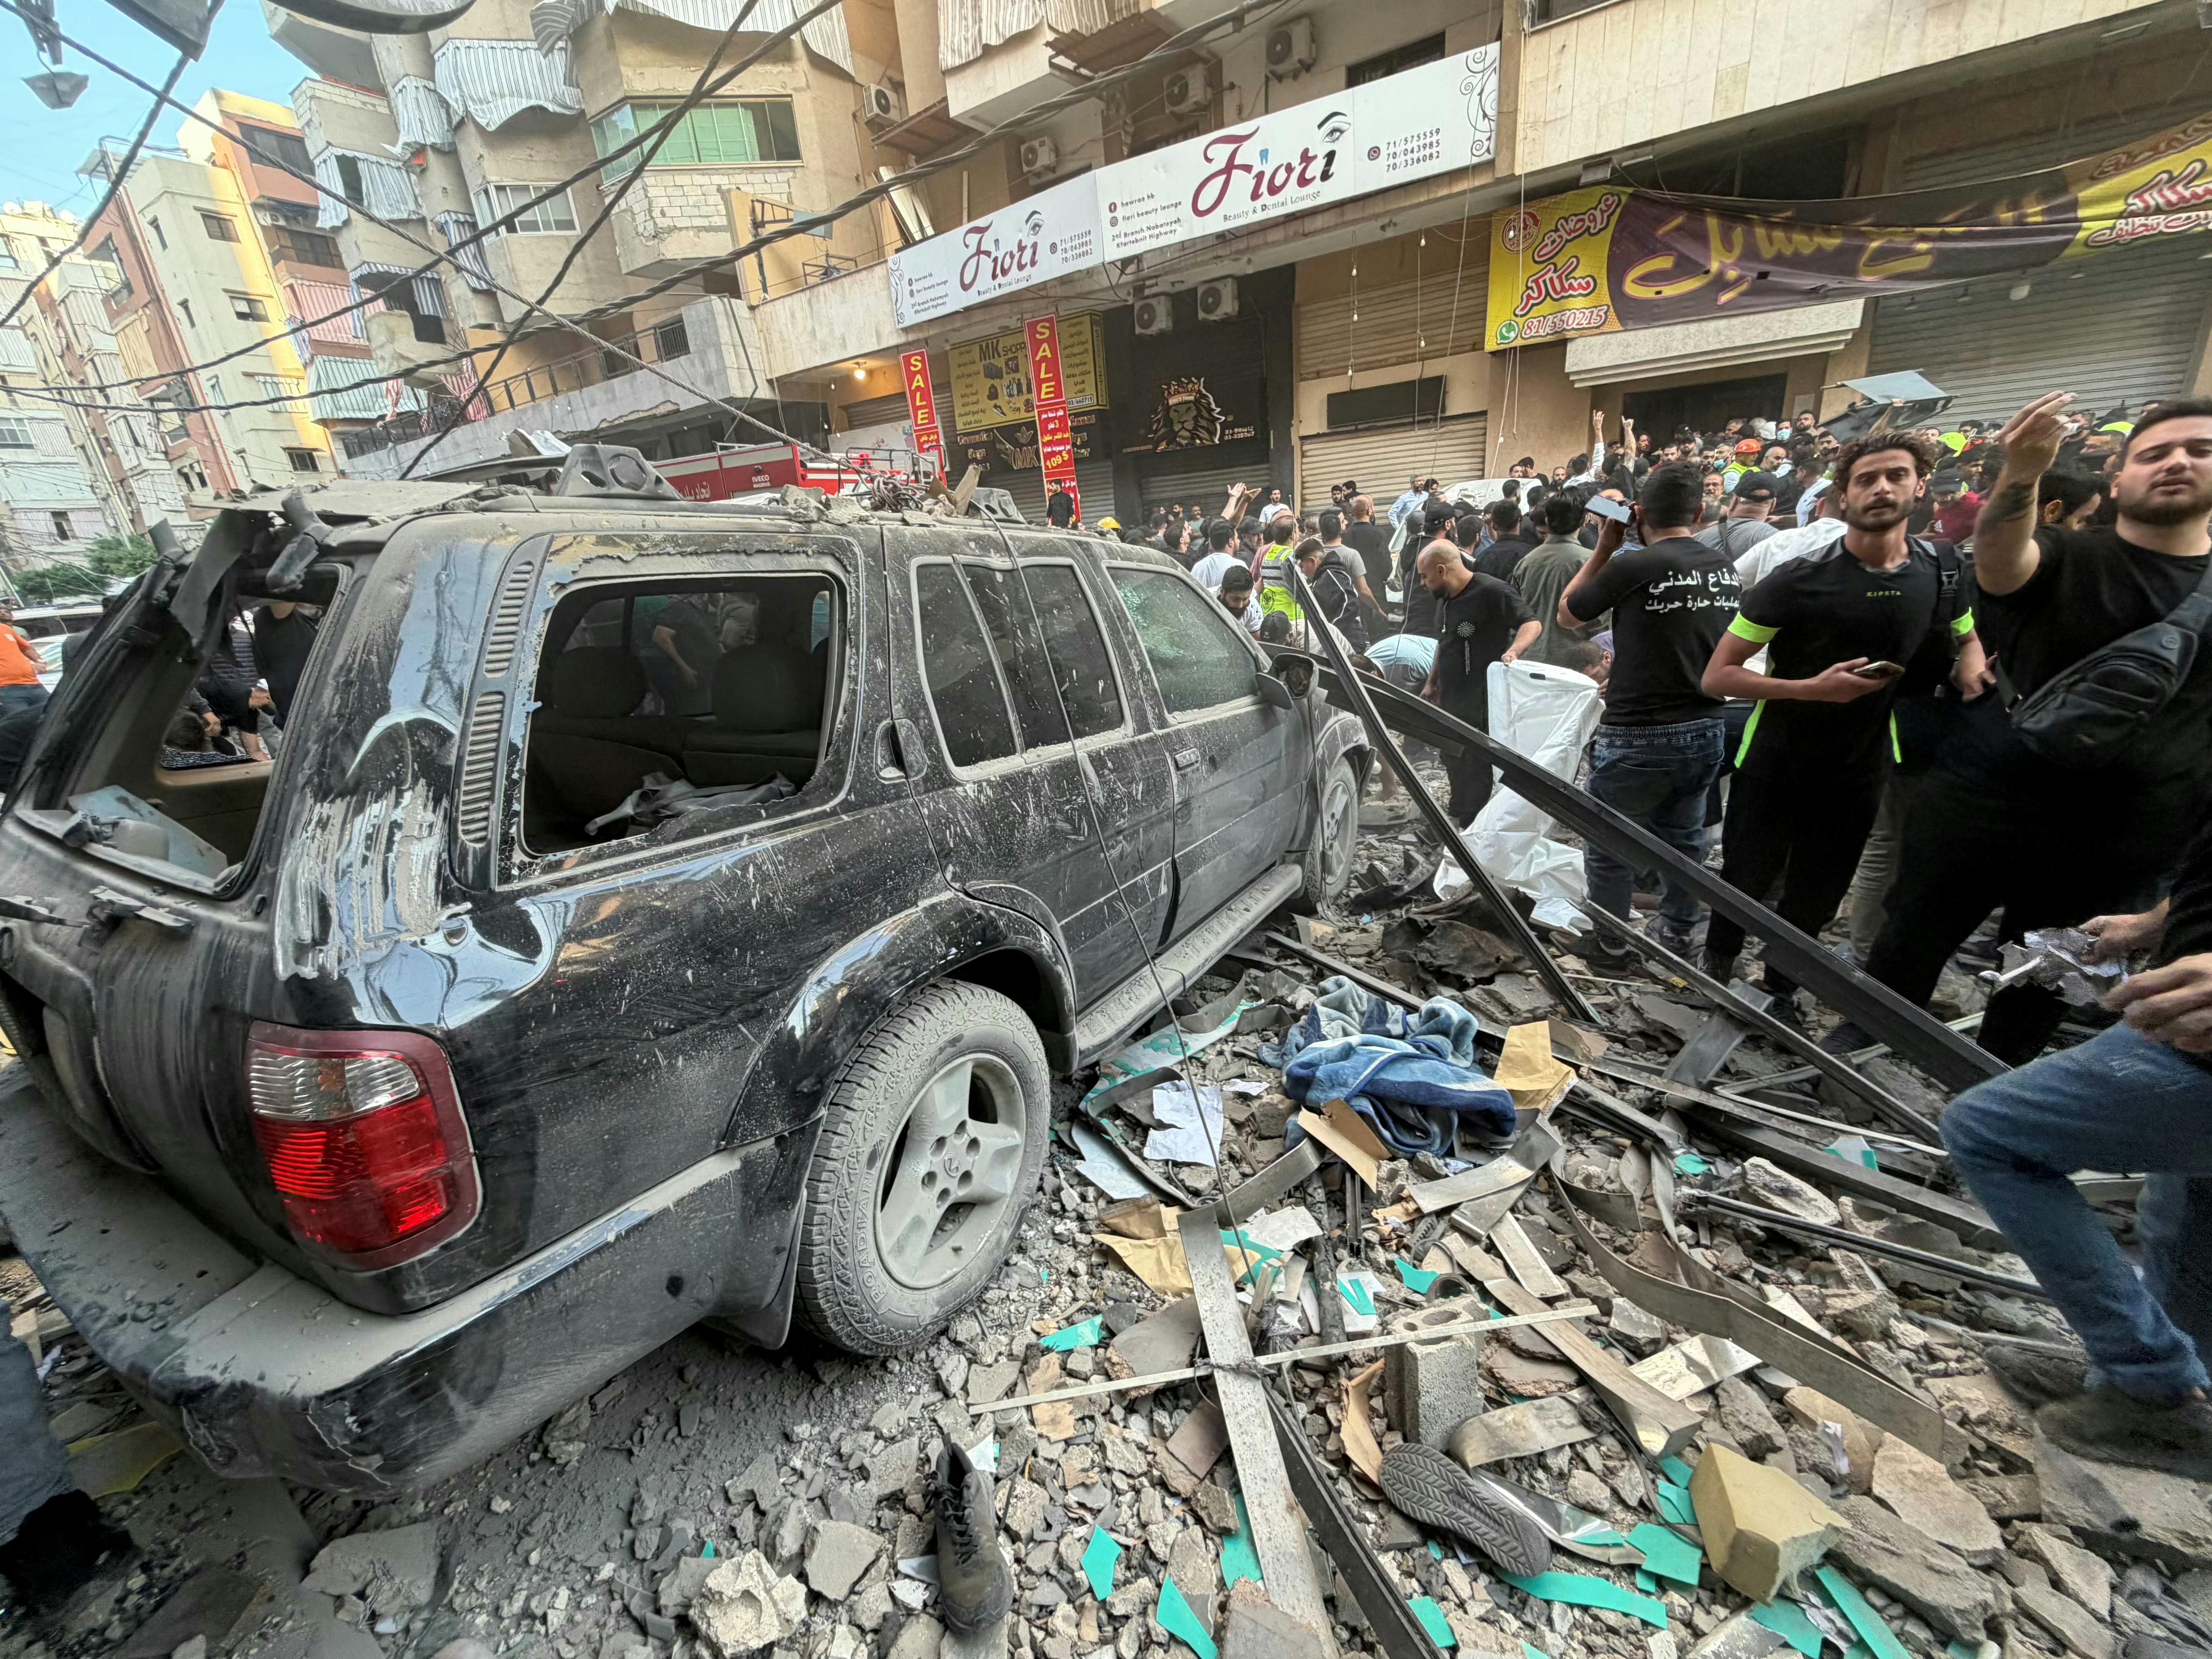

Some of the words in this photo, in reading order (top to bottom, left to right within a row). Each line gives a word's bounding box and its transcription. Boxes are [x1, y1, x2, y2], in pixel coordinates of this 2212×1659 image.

[1386, 128, 1440, 150] 71/575559
[1386, 139, 1440, 161] 70/043985
[1192, 126, 1336, 218] Fiori
[1386, 151, 1440, 172] 70/336082
[1121, 197, 1145, 208] hawraa
[1122, 214, 1135, 222] fiori
[1137, 208, 1158, 218] beauty
[1160, 201, 1182, 211] lounge
[1223, 210, 1249, 222] Beauty
[1252, 206, 1258, 215] &
[1261, 197, 1287, 212] Dental
[1290, 191, 1321, 204] Lounge
[1060, 230, 1091, 246] 71/575559
[1124, 227, 1144, 238] Branch
[1149, 228, 1177, 240] Highway
[1534, 194, 1619, 262] عروضات
[960, 220, 1038, 292] Fiori
[1061, 239, 1092, 255] 70/043985
[1061, 248, 1092, 264] 70/336082
[1515, 257, 1594, 315] سكاكر
[1522, 305, 1608, 338] 81/550215
[979, 339, 1001, 362] MK
[1036, 322, 1055, 399] SALE
[910, 356, 929, 424] SALE
[1068, 396, 1093, 406] 03/660715
[1649, 569, 1701, 595] المدني
[1645, 599, 1683, 613] حريك
[1687, 595, 1711, 611] حارة
[857, 1170, 888, 1304] ROADIAN
